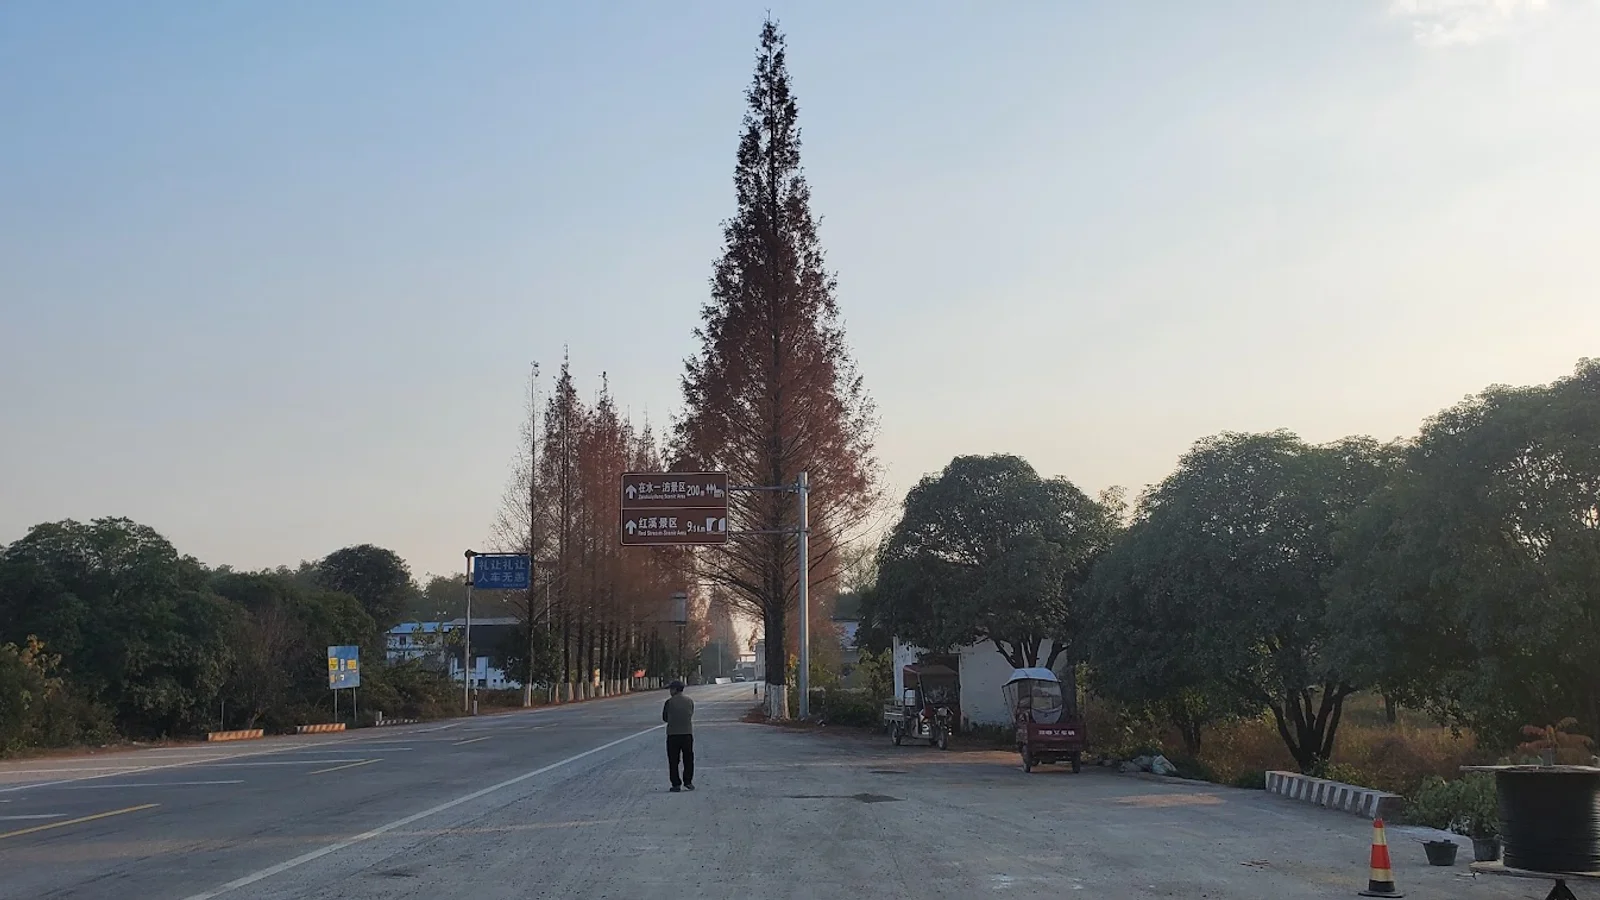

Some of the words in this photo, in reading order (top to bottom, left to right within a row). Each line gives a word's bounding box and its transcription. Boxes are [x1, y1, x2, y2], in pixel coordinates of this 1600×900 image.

[638, 517, 678, 528] 红溪景区
[478, 558, 526, 570] 礼让礼让
